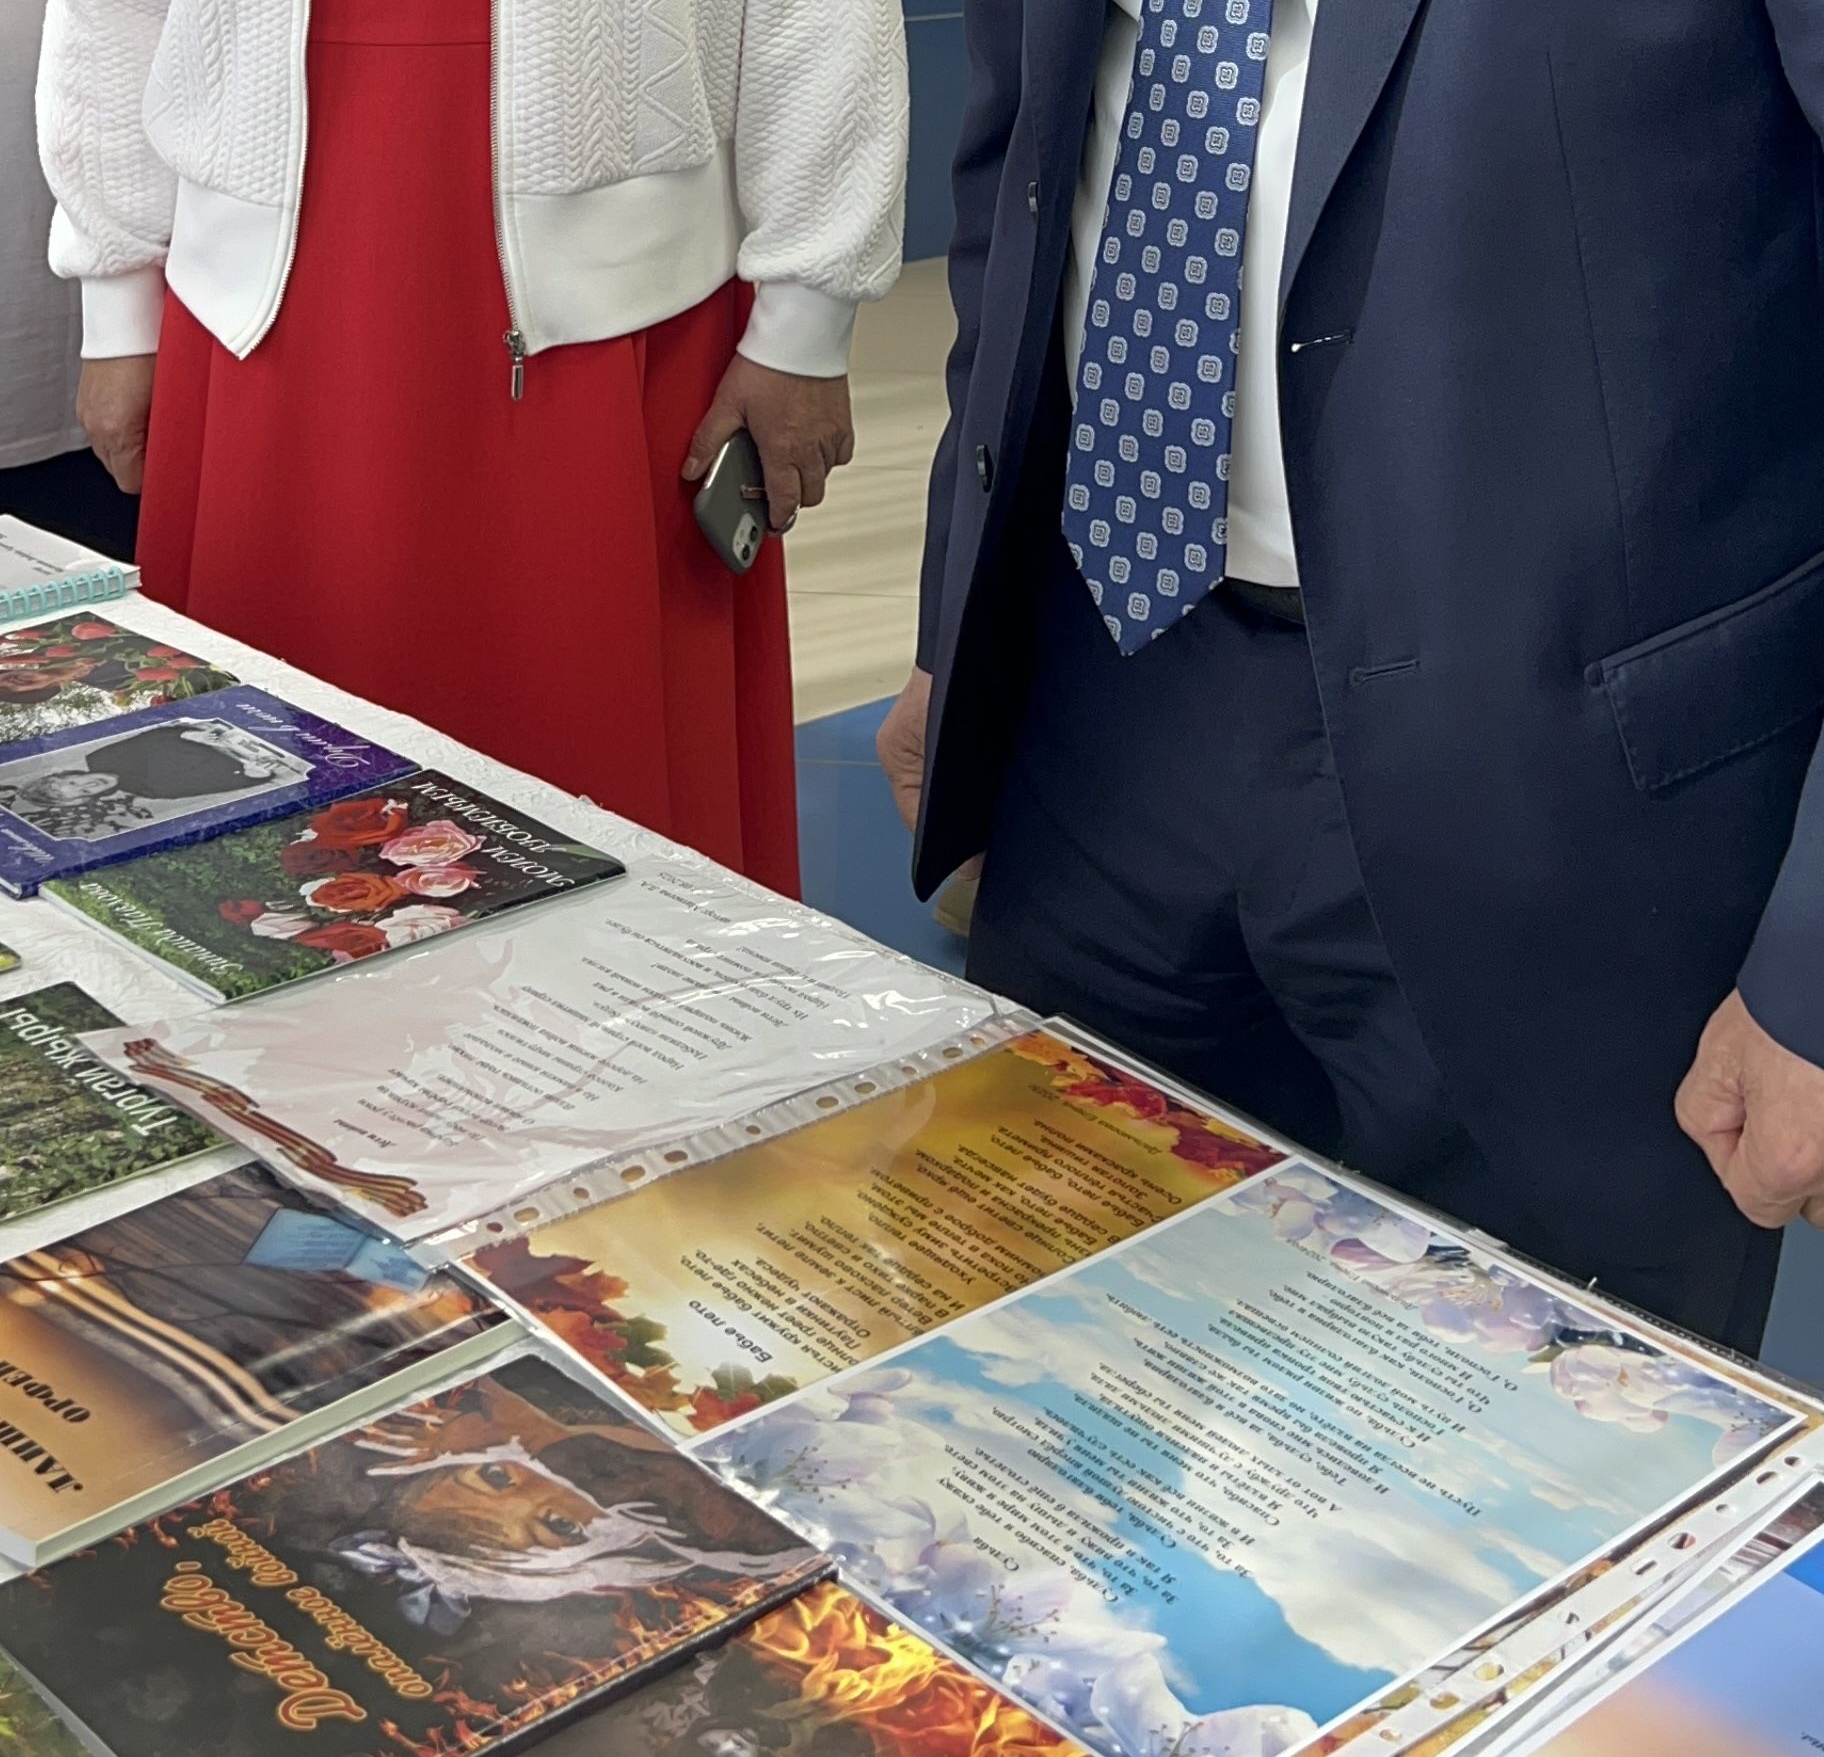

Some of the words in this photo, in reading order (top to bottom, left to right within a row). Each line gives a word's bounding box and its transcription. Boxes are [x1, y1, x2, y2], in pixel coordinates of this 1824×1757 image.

[411, 780, 568, 854] ЛЮБИМЫМ
[481, 845, 576, 888] МОИМ
[79, 883, 163, 930] Павлова
[153, 928, 243, 975] Зинаида
[0, 1007, 98, 1070] жыры
[66, 1066, 178, 1137] Тургай
[187, 1518, 299, 1586] войной
[161, 1560, 367, 1729] Детство,
[286, 1586, 433, 1697] опалённое
